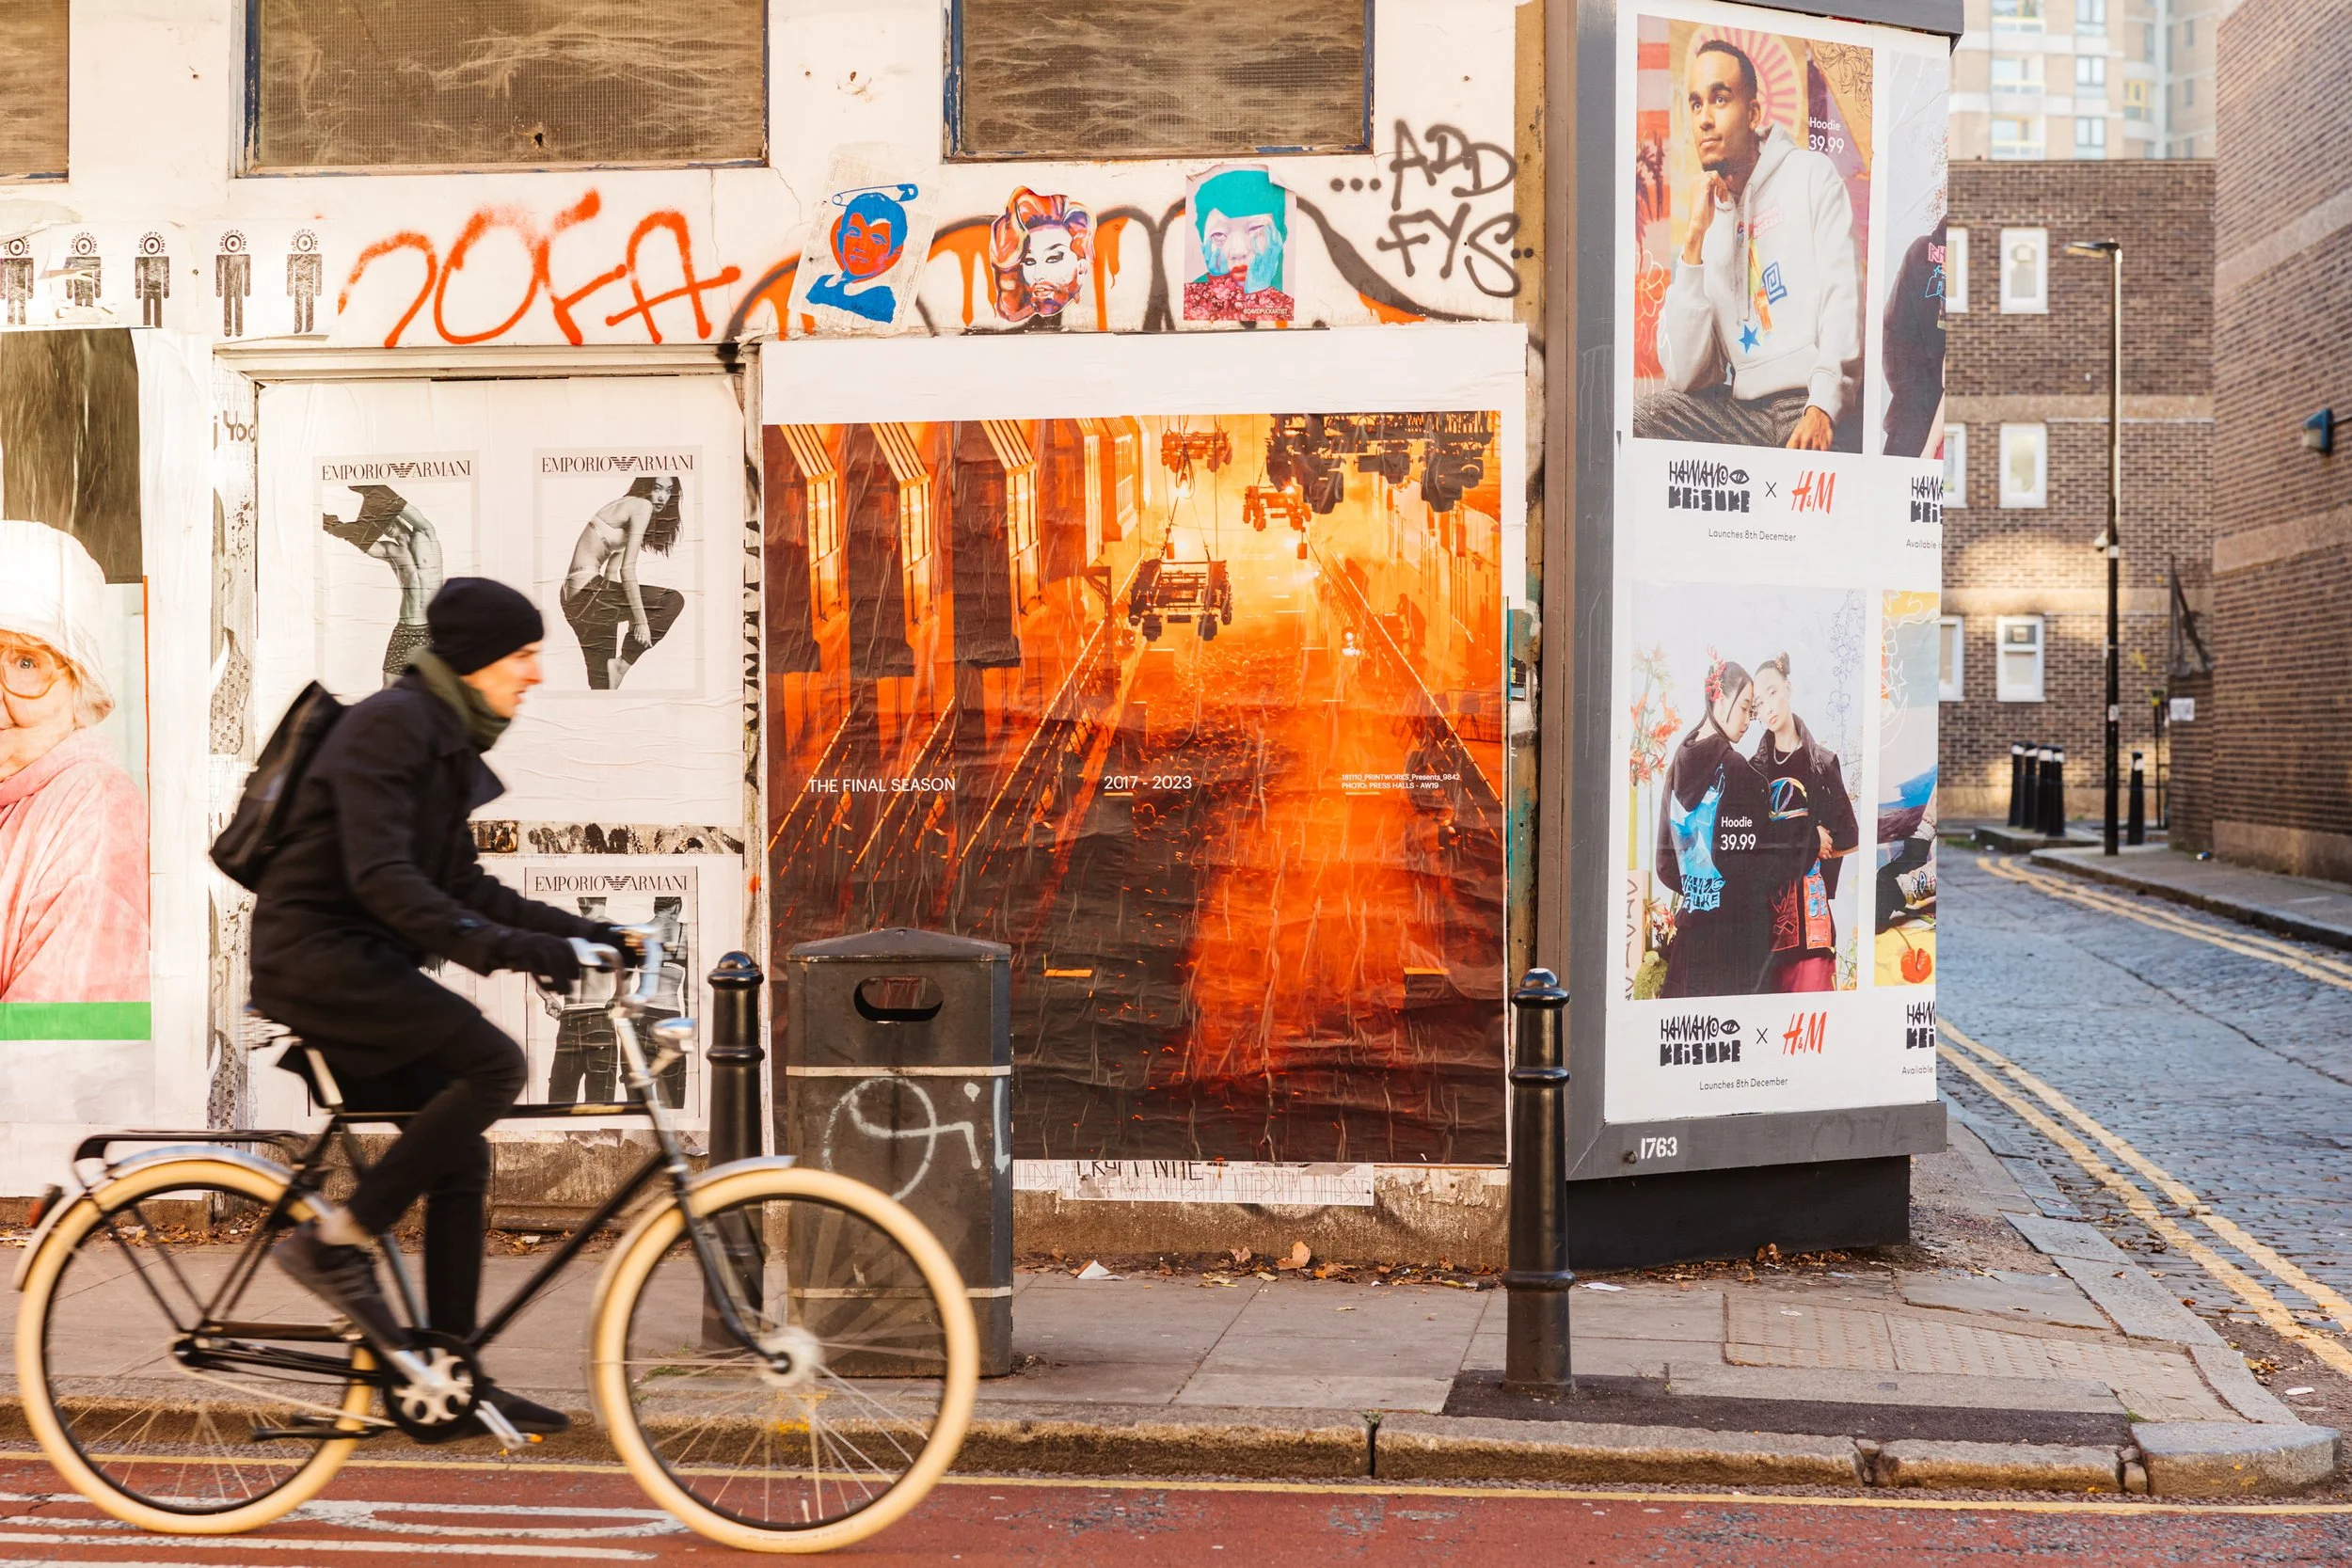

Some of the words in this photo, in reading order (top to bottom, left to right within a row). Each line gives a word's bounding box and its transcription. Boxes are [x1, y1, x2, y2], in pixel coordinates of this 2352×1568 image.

[1809, 117, 1841, 131] Hoodie
[1809, 134, 1844, 153] 39.99
[322, 464, 390, 481] EMPORIO
[411, 460, 471, 477] ARMANI
[542, 456, 612, 472] EMPORIO
[635, 454, 693, 471] ARMANI
[1791, 469, 1836, 515] H&M
[1708, 529, 1743, 539] Launches
[1744, 530, 1757, 540] 8th
[1759, 531, 1796, 542] December
[1906, 539, 1936, 548] Available
[808, 779, 838, 793] THE
[842, 778, 887, 792] FINAL
[891, 777, 956, 792] SEASON
[1104, 776, 1137, 789] 2017
[1152, 775, 1192, 789] 2023
[1721, 816, 1753, 828] Hoodie
[1720, 833, 1756, 850] 39.99
[535, 876, 606, 892] EMPORIO
[628, 875, 688, 891] ARMANI
[1783, 1011, 1827, 1055] H&M
[1902, 1065, 1933, 1075] Available
[1699, 1081, 1734, 1091] Launches
[1736, 1080, 1749, 1090] 8th
[1751, 1077, 1788, 1088] December
[1640, 1136, 1677, 1160] 1763
